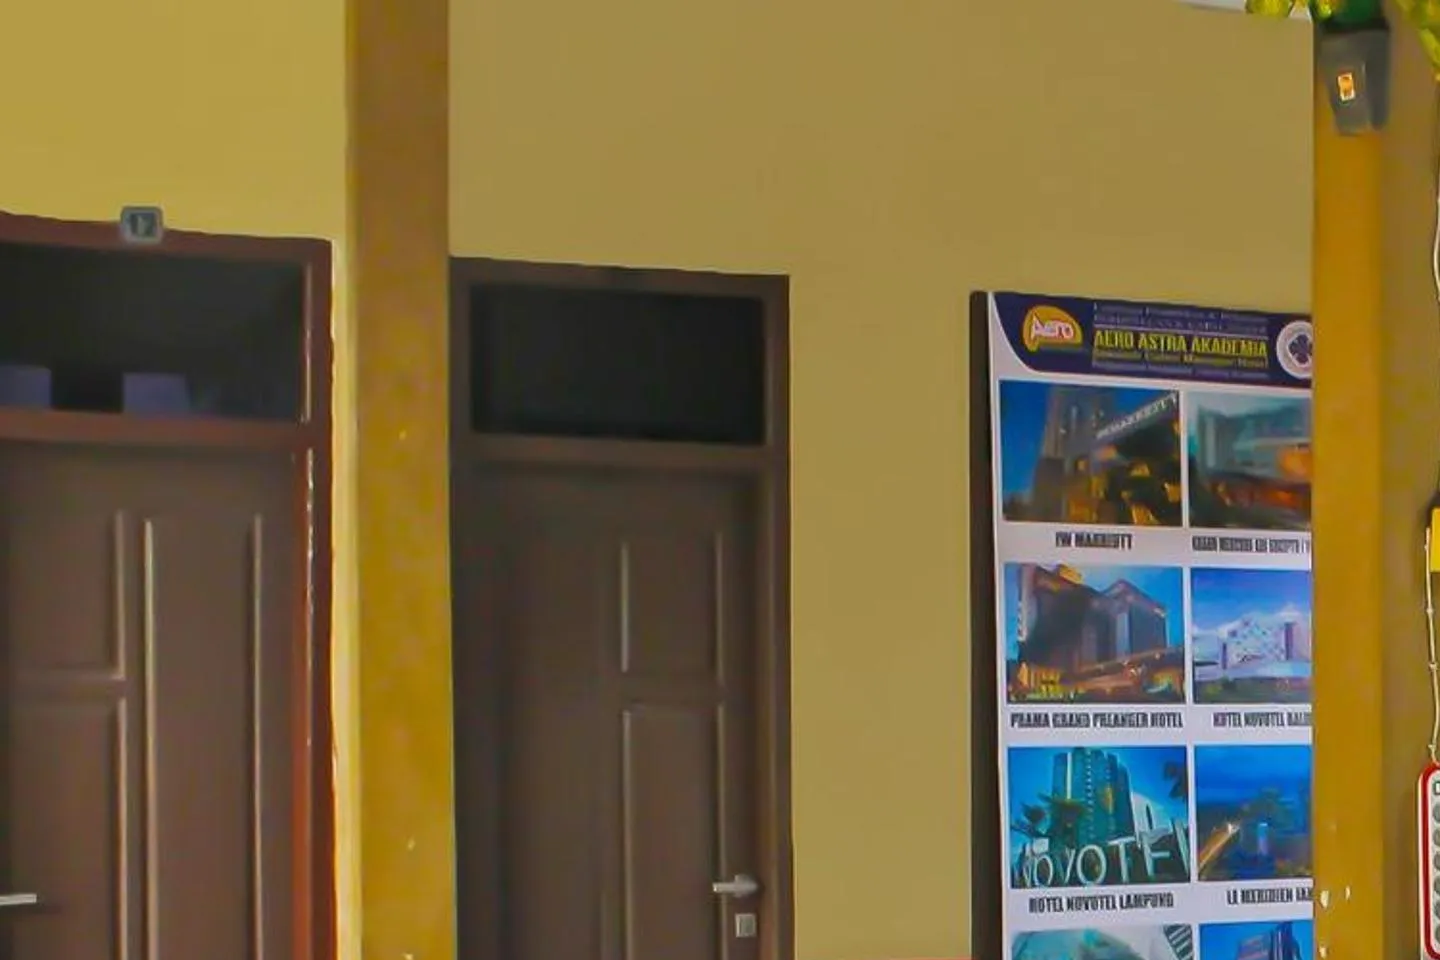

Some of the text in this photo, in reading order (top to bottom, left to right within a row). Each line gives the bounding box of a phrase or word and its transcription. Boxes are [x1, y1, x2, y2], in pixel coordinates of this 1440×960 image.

[1031, 316, 1074, 340] Aero
[1094, 329, 1267, 357] AERO ASTRA AKADEMIA
[1075, 533, 1132, 549] MARRIOTT
[1010, 712, 1050, 728] PRAMA
[1052, 712, 1090, 728] GRAND
[1150, 712, 1183, 728] HOTEL
[1029, 891, 1174, 913] HOTEL NOVOTEL LAMPUNG
